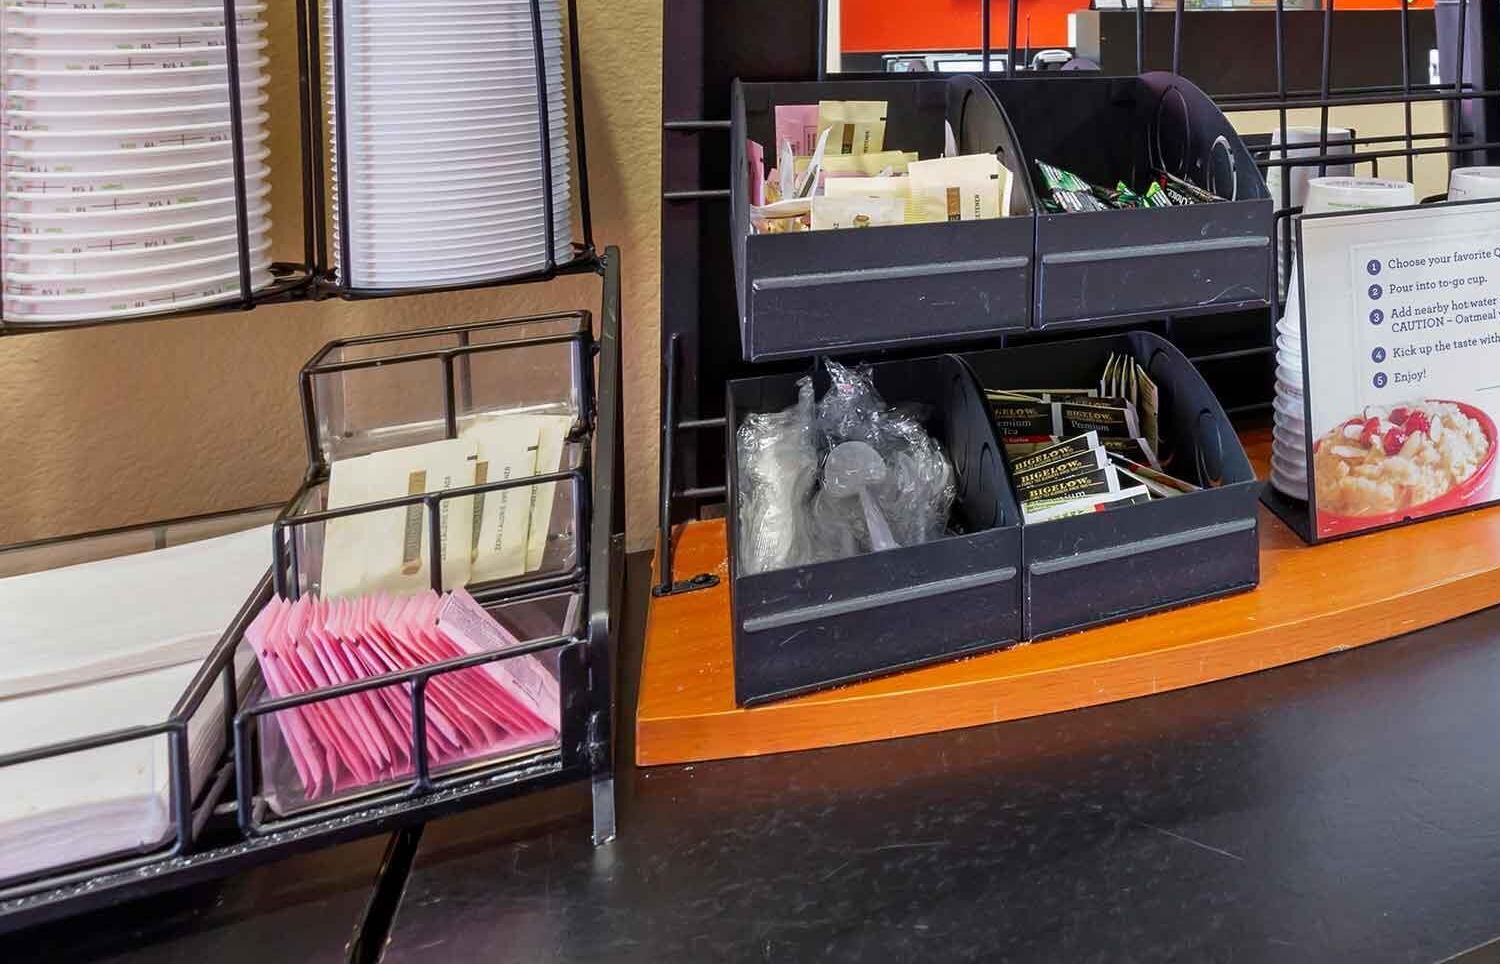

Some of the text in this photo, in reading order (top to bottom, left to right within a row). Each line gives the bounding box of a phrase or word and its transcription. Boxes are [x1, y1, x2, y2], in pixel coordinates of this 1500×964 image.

[1388, 257, 1427, 269] Choose
[1428, 255, 1451, 267] your
[1454, 251, 1492, 262] favorite
[1389, 282, 1414, 294] Pour
[1416, 279, 1437, 290] into
[1439, 277, 1465, 288] to-go
[1467, 275, 1488, 286] cup.
[1391, 306, 1412, 319] Add
[1414, 301, 1449, 315] nearby
[1451, 298, 1469, 311] hot
[1470, 296, 1498, 308] water
[1391, 316, 1445, 333] CAUTION
[1455, 308, 1497, 324] Oatmeal
[1392, 344, 1418, 359] Kick
[1419, 345, 1433, 357] up
[1435, 339, 1451, 353] the
[1453, 337, 1478, 350] taste
[1479, 333, 1500, 346] with
[1394, 368, 1428, 384] Enjoy!
[1066, 410, 1109, 421] BIGELOW
[1015, 446, 1071, 471] BIGELOW
[1021, 460, 1081, 484] BIGELOW
[1030, 477, 1090, 498] BIGELOW
